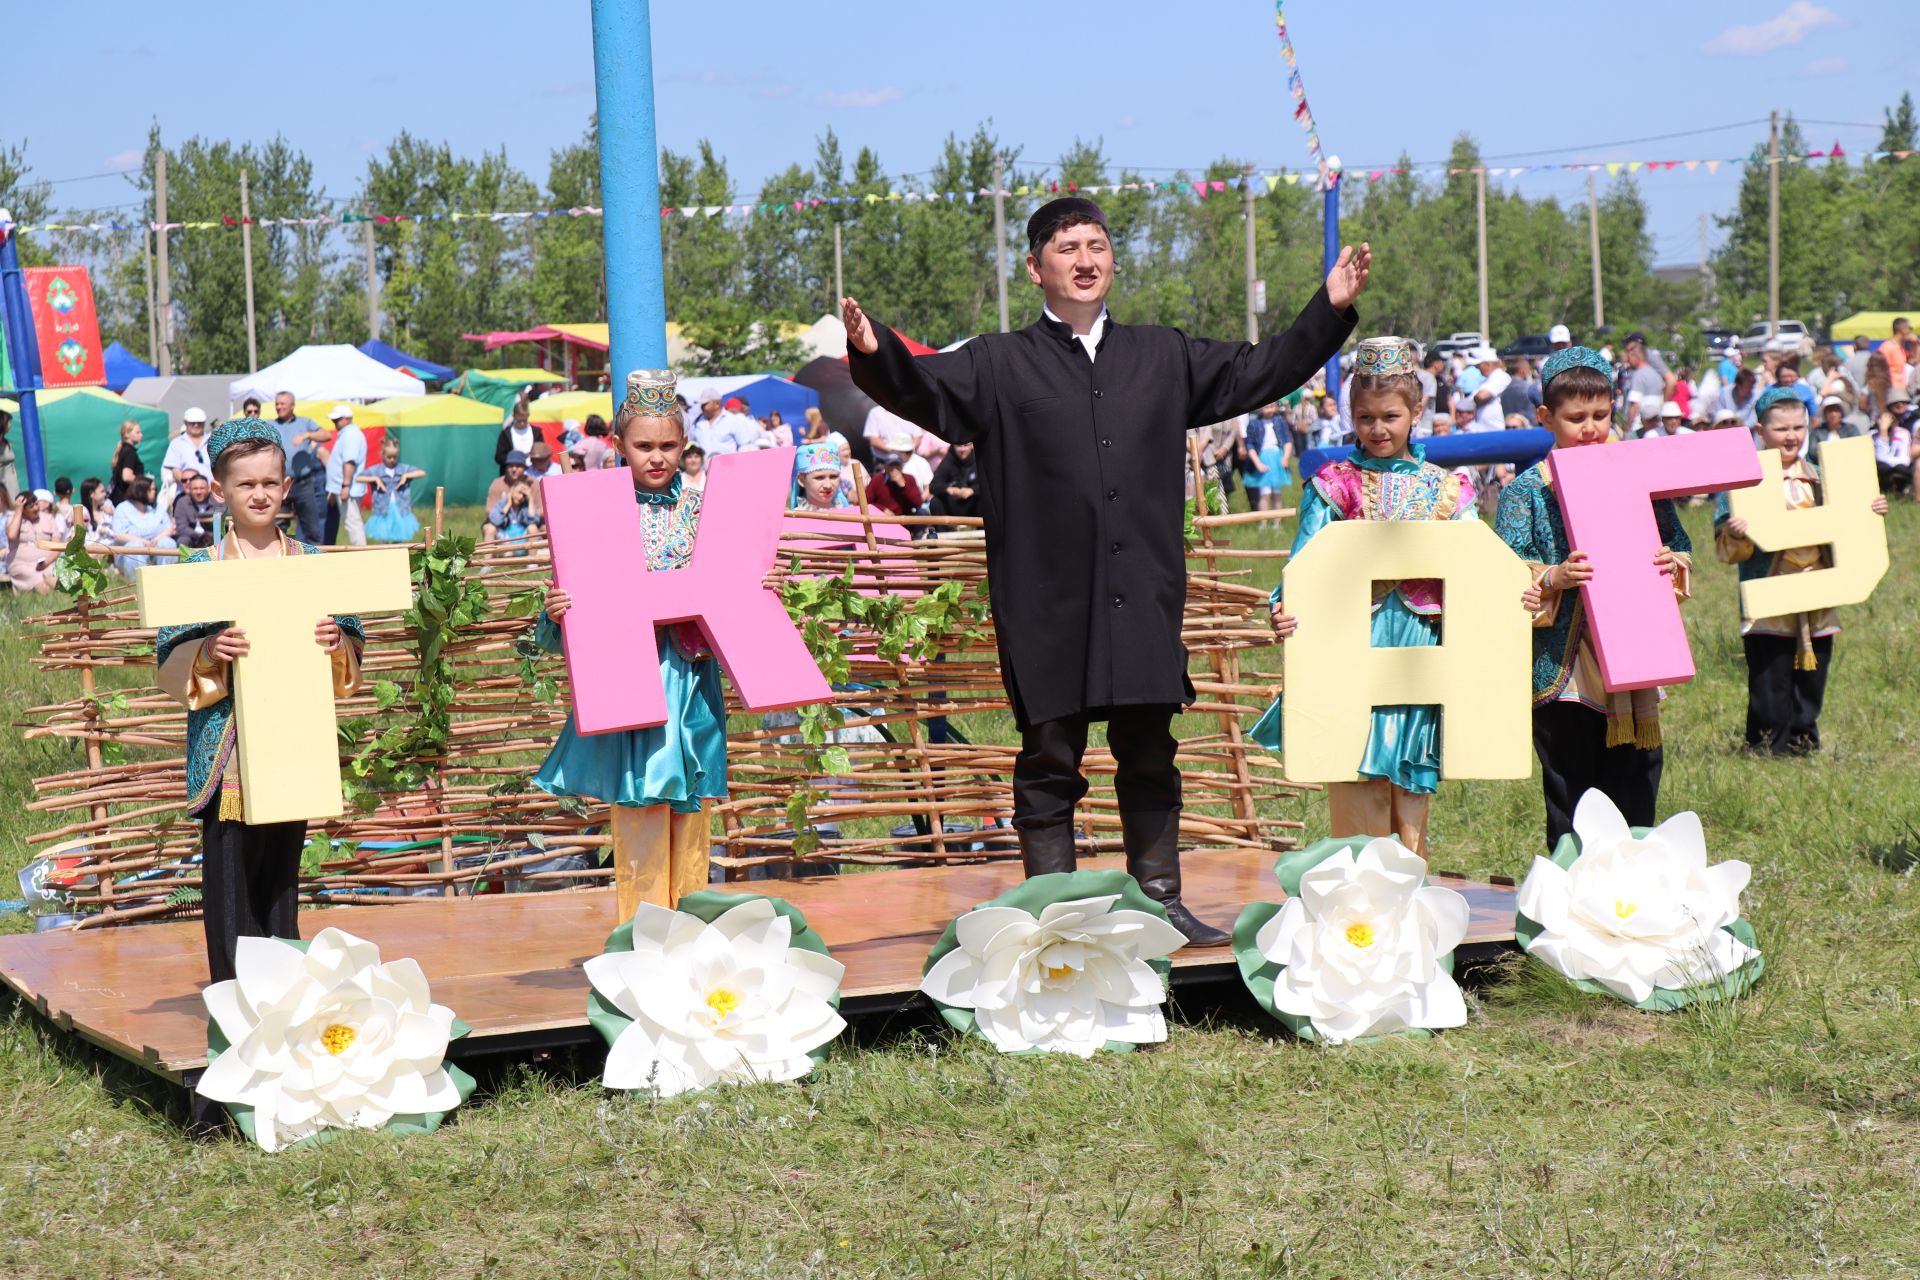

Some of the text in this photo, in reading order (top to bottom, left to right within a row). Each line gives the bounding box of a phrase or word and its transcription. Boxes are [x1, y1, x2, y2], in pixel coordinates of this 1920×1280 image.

[1282, 519, 1533, 782] А
[1550, 426, 1764, 693] Г
[1731, 435, 1890, 620] У
[136, 548, 413, 825] Т
